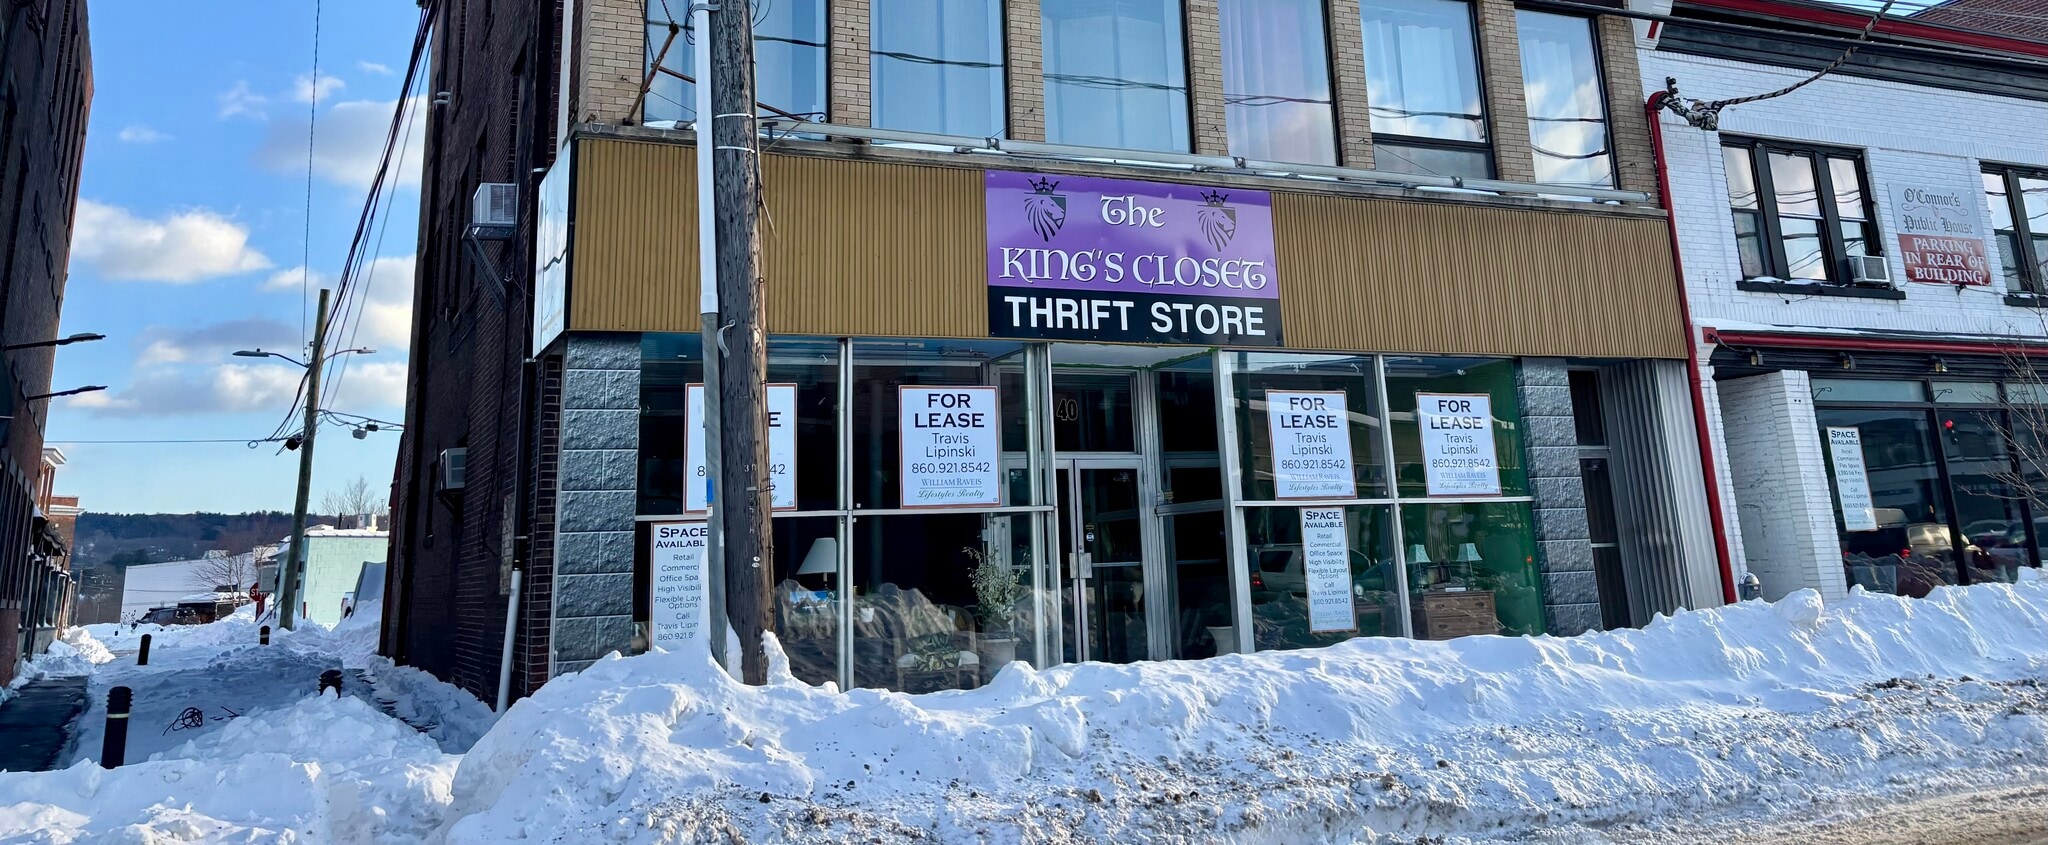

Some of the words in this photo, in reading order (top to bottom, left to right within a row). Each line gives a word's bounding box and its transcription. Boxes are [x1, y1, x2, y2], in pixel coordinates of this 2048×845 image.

[1903, 187, 1961, 207] O'Connor's
[1100, 194, 1166, 228] The
[1903, 214, 1938, 233] Public
[1940, 217, 1974, 235] House
[1913, 237, 1974, 255] PARKING
[1905, 251, 1922, 265] IN
[1927, 253, 1966, 269] REAR
[1967, 256, 1985, 270] OF
[999, 247, 1124, 283] KING'S
[1132, 252, 1268, 290] CLOSET
[1915, 267, 1984, 286] BUILDING
[1004, 296, 1134, 331] THRIFT
[1151, 302, 1266, 337] STORE
[927, 393, 971, 409] FOR
[1289, 397, 1326, 411] FOR
[1438, 400, 1472, 413] FOR
[1056, 399, 1079, 421] 40
[914, 412, 985, 428] LEASE
[1280, 415, 1339, 429] LEASE
[1430, 416, 1484, 430] LEASE
[932, 432, 970, 445] Travis
[1295, 432, 1327, 443] Travis
[1444, 433, 1473, 443] Travis
[1831, 430, 1857, 439] SPACE
[926, 446, 976, 460] Lipinski
[1291, 444, 1333, 457] Lipinski
[1441, 444, 1479, 456] Lipinski
[911, 462, 990, 474] 860.921.8542
[1281, 459, 1346, 470] 860.921.8542
[1432, 458, 1491, 468] 860.921.8542
[921, 478, 956, 487] WILLIAM
[956, 477, 983, 486] RAVEIS
[917, 489, 956, 499] Lifestyles
[958, 489, 985, 499] Realty
[1305, 510, 1340, 521] SPACE
[1304, 521, 1343, 529] AVAILABLE
[660, 527, 708, 538] SPACE
[656, 540, 705, 549] AVAILABL
[1326, 550, 1343, 558] Space
[660, 575, 682, 583] Office
[657, 586, 675, 594] High
[677, 584, 702, 592] Visibili
[655, 596, 684, 604] Flexible
[668, 602, 698, 610] Options
[675, 612, 690, 620] Call
[680, 621, 699, 629] Lipin
